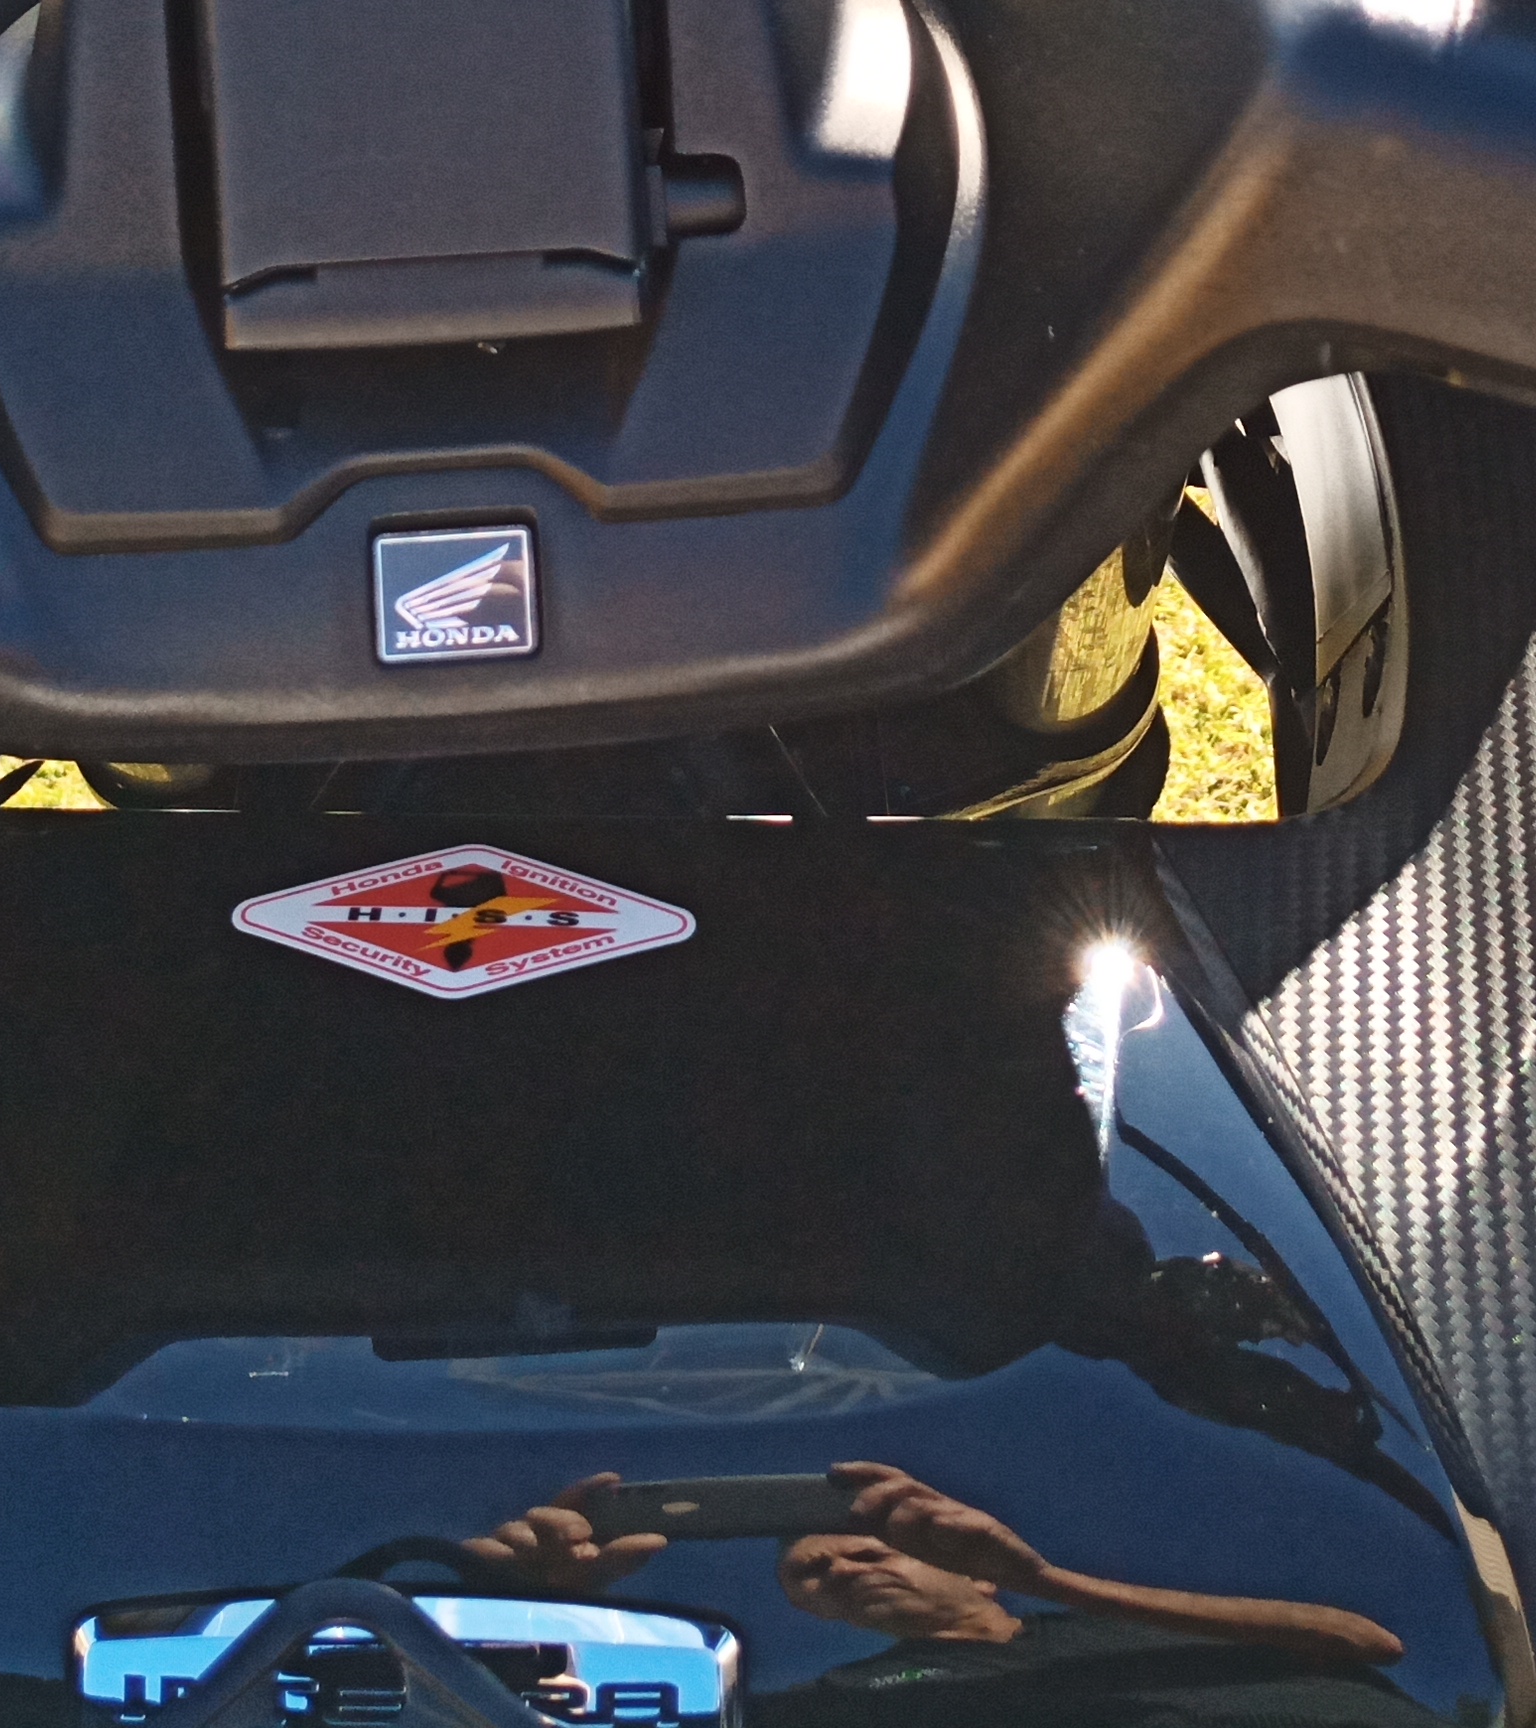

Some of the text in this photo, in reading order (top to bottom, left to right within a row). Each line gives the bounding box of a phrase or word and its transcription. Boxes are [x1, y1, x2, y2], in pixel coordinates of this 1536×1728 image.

[395, 624, 520, 650] HONDA
[330, 859, 619, 908] Honda Ignition
[301, 925, 616, 979] Security System
